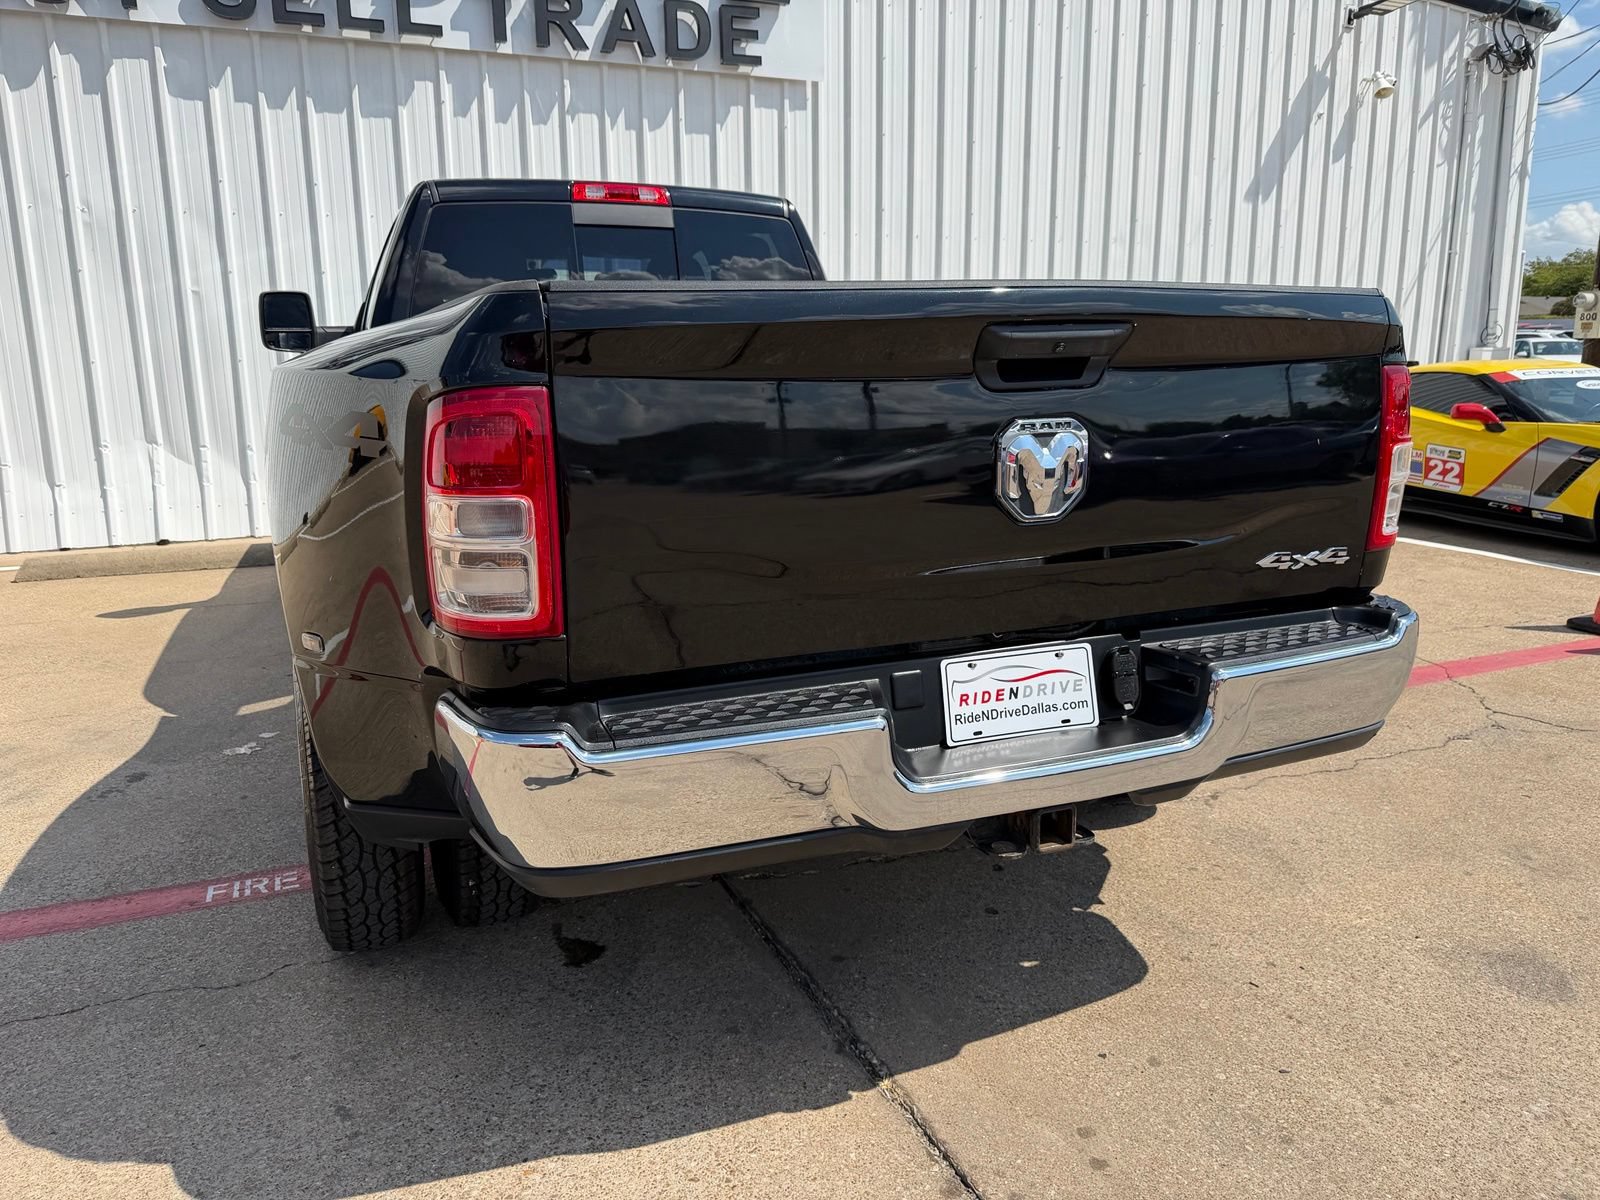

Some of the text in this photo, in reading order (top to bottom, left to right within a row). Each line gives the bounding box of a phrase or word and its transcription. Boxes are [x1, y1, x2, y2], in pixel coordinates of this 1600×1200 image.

[1019, 421, 1073, 431] RAM
[1427, 459, 1461, 485] 22
[954, 699, 1089, 726] RideNDriveDallas.com
[205, 871, 300, 903] FIRE
